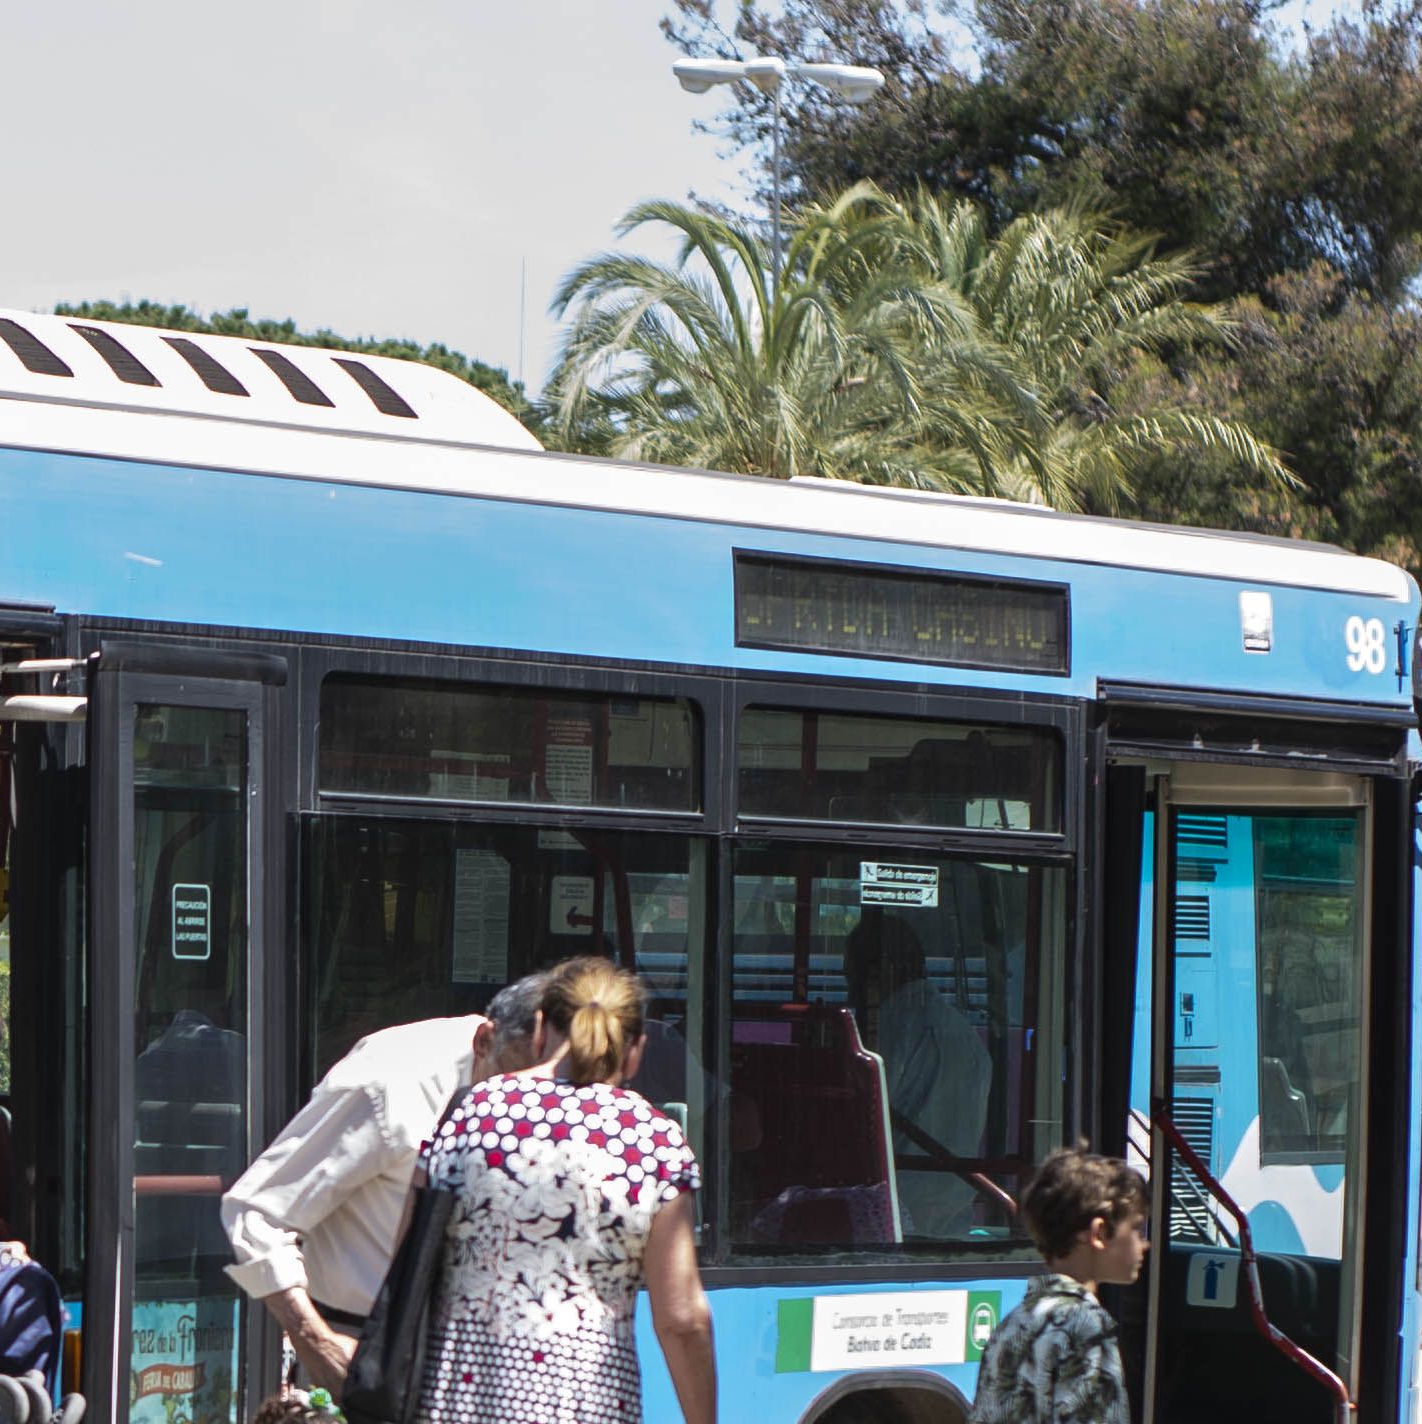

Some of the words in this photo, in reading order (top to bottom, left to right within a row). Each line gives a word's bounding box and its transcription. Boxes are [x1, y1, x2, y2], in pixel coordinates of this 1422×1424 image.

[1345, 615, 1387, 675] 98
[881, 1312, 893, 1328] de
[883, 1334, 897, 1351] de
